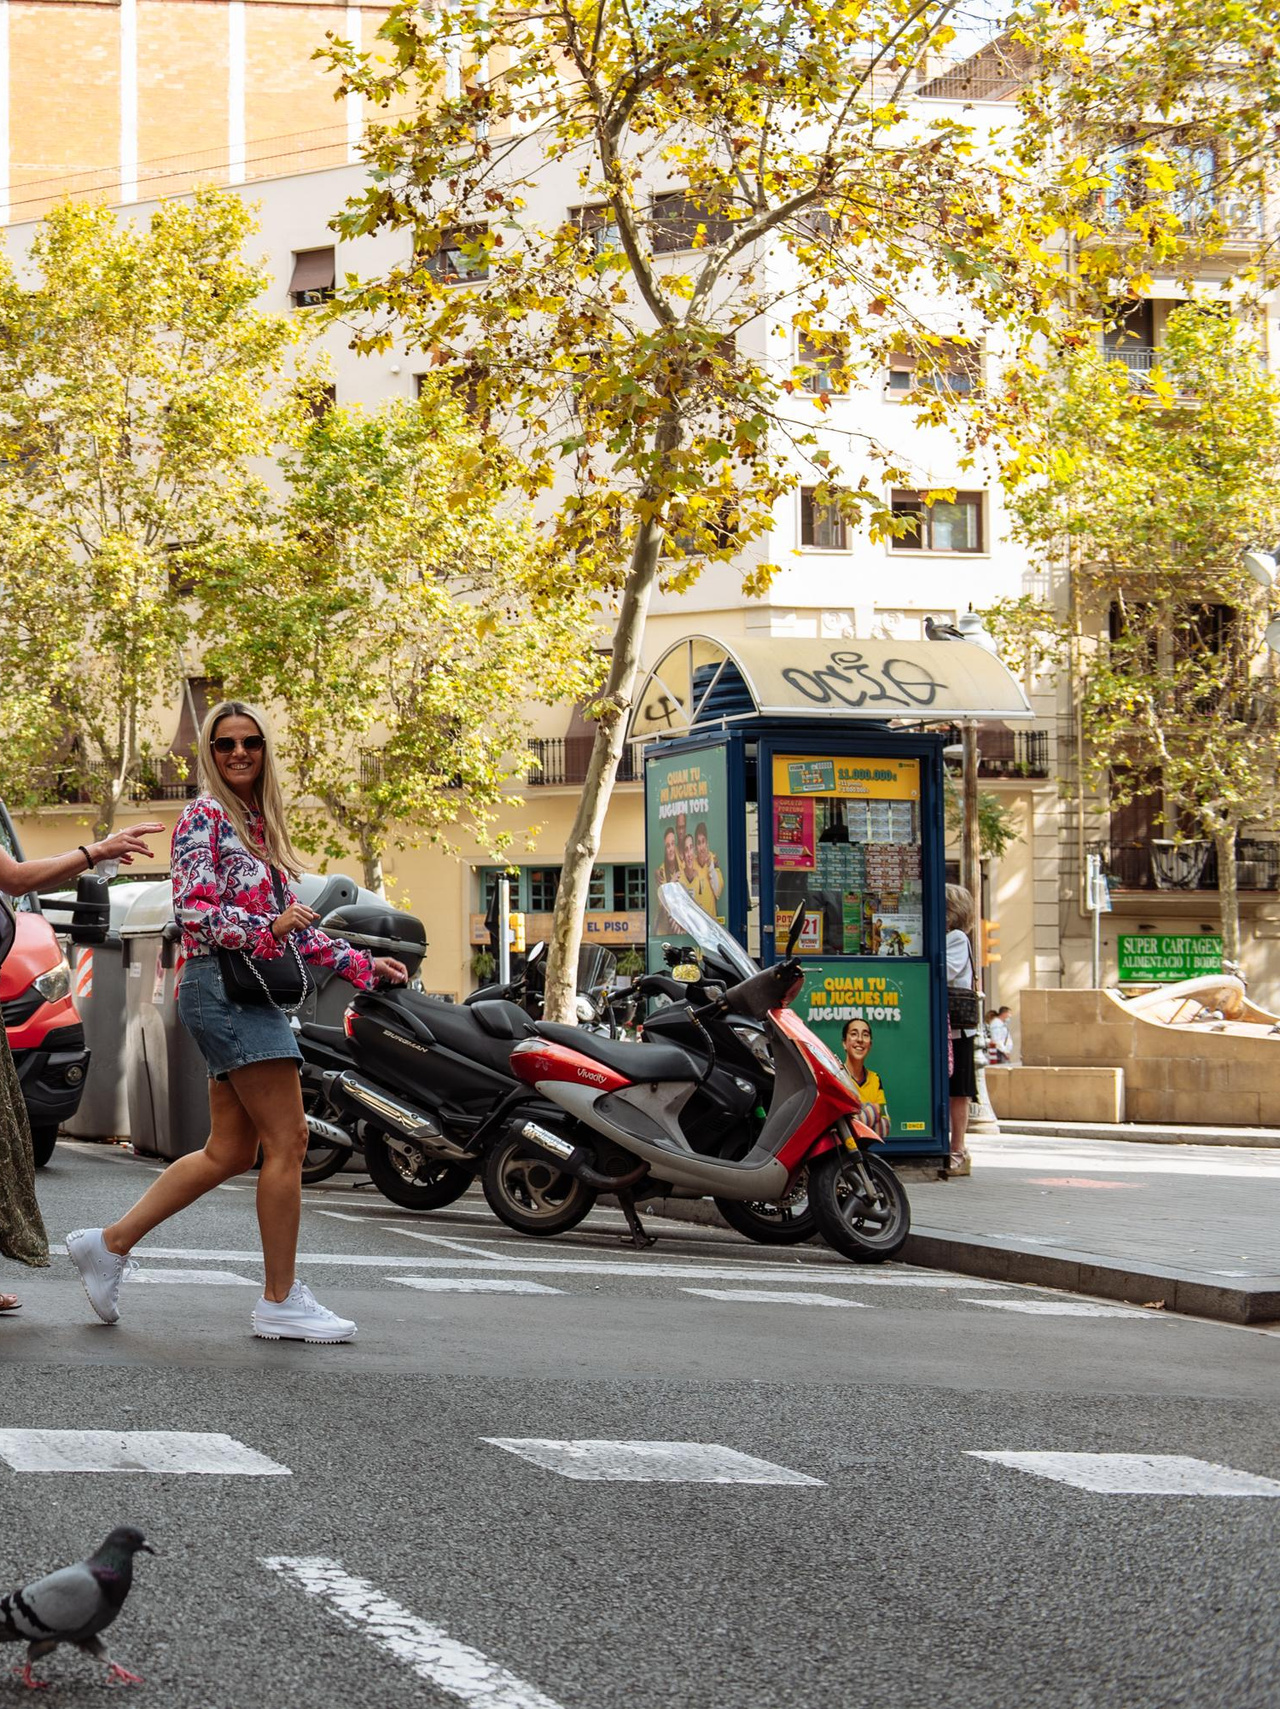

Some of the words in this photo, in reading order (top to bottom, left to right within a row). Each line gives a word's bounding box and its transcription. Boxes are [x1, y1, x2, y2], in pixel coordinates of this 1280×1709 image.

[690, 766, 701, 782] TU
[689, 798, 709, 814] TOTS
[587, 922, 600, 932] EL
[604, 921, 629, 932] PISO
[1123, 937, 1158, 954] SUPER
[1162, 937, 1222, 954] CARTAGEN
[824, 977, 864, 991] QUAN
[867, 977, 886, 991] TU
[811, 991, 827, 1006] HI
[883, 991, 899, 1006] HI
[807, 1007, 863, 1022] JUGUEM
[866, 1007, 901, 1022] TOTS
[577, 1068, 608, 1084] Vivacity
